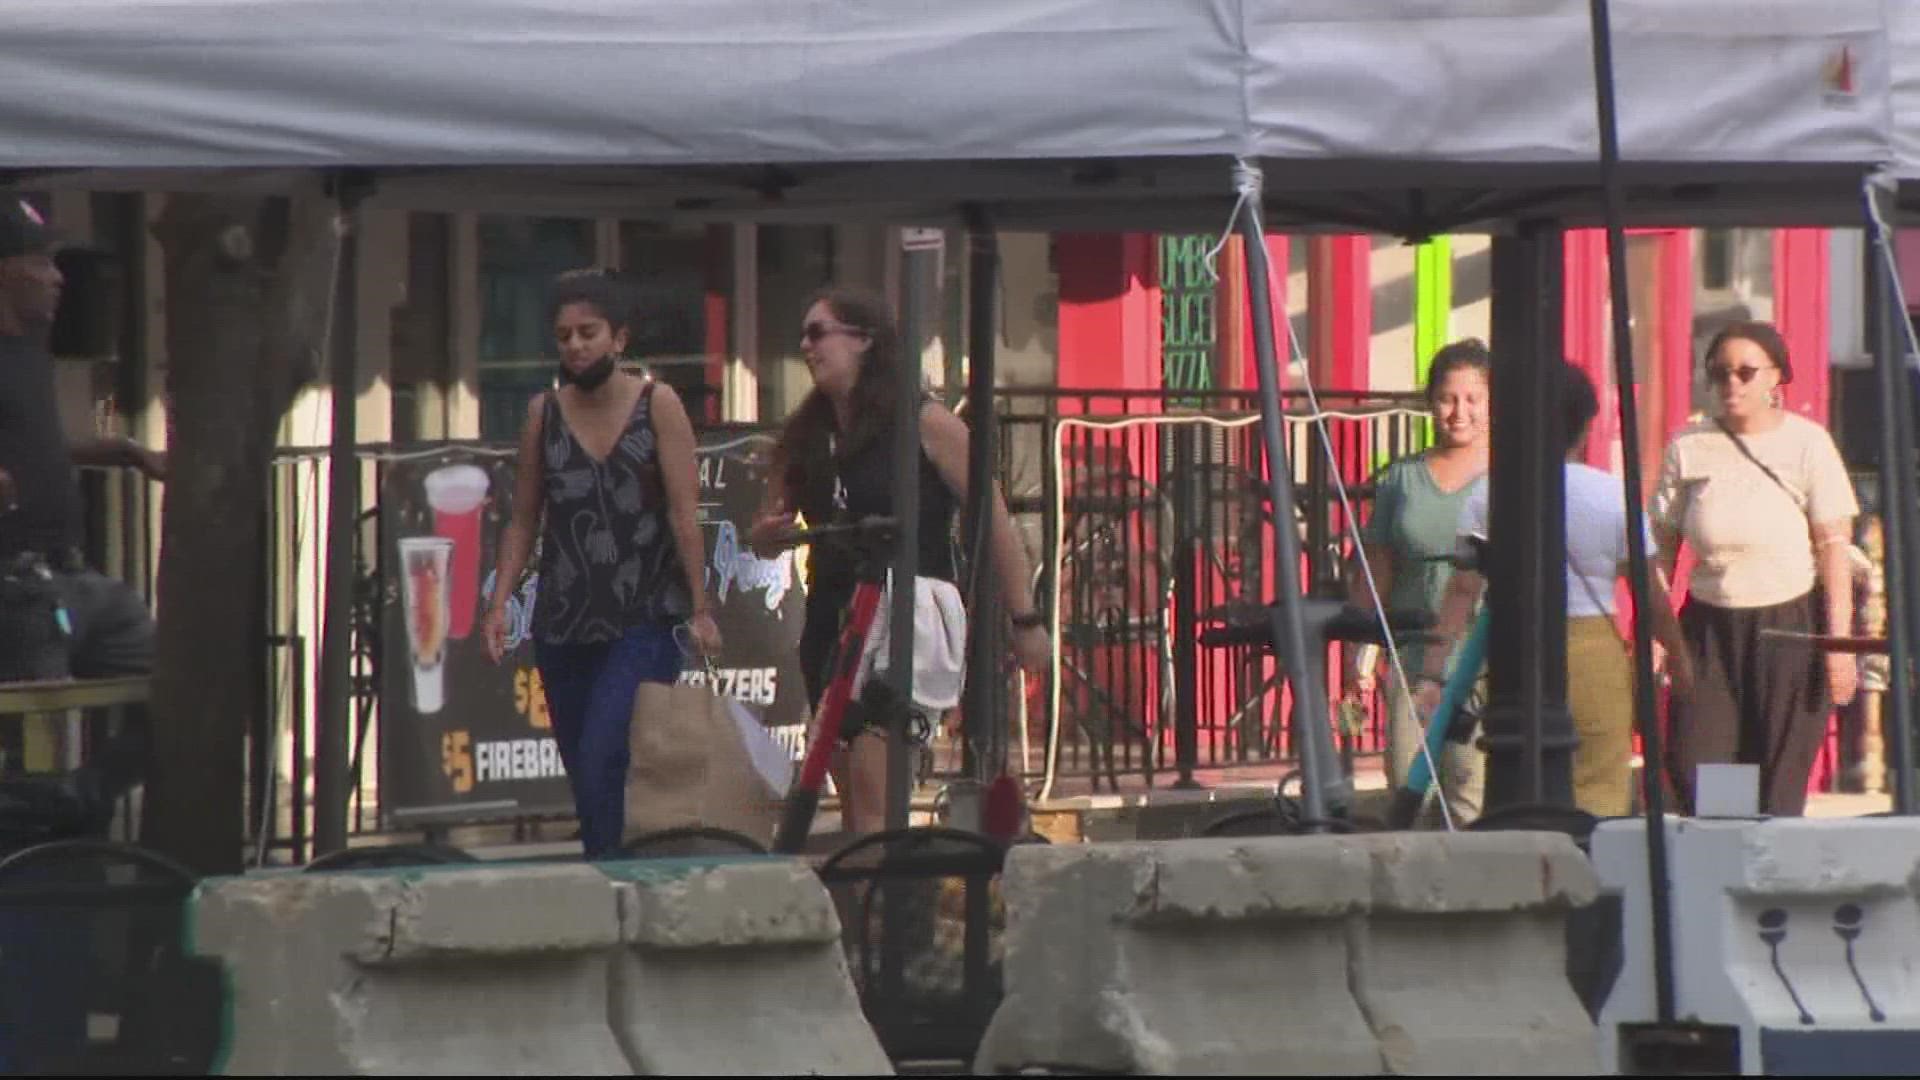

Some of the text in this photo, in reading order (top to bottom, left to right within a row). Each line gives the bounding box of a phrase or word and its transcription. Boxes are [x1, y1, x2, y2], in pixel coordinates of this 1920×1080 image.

[442, 723, 807, 794] $5 FIREBA OTS
